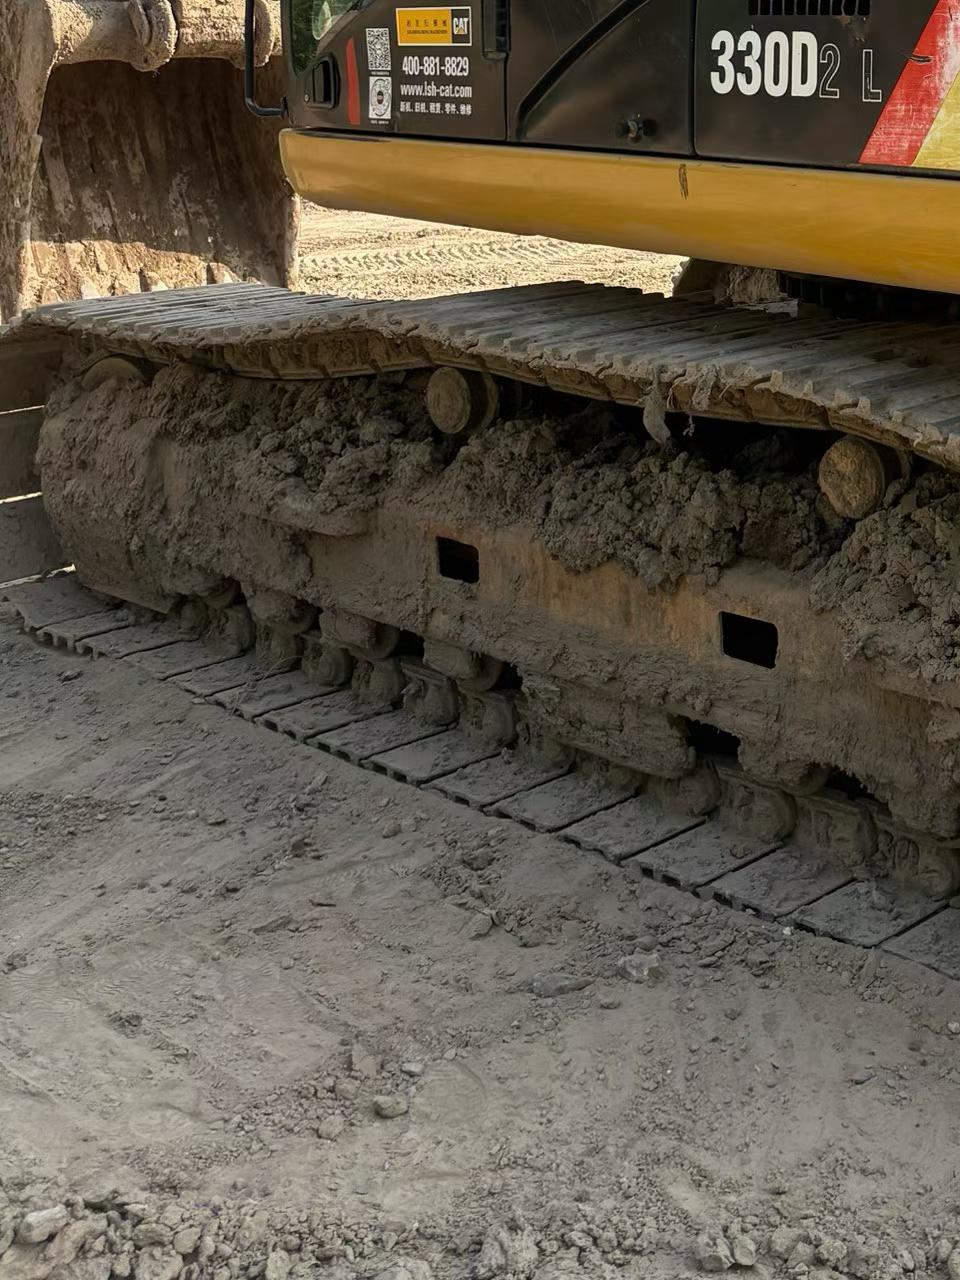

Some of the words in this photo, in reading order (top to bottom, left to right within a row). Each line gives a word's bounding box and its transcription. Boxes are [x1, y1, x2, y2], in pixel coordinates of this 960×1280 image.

[453, 17, 469, 35] CAT
[402, 56, 469, 76] 400-881-8829
[861, 49, 883, 103] L
[400, 81, 472, 98] www.lsh-cat.com
